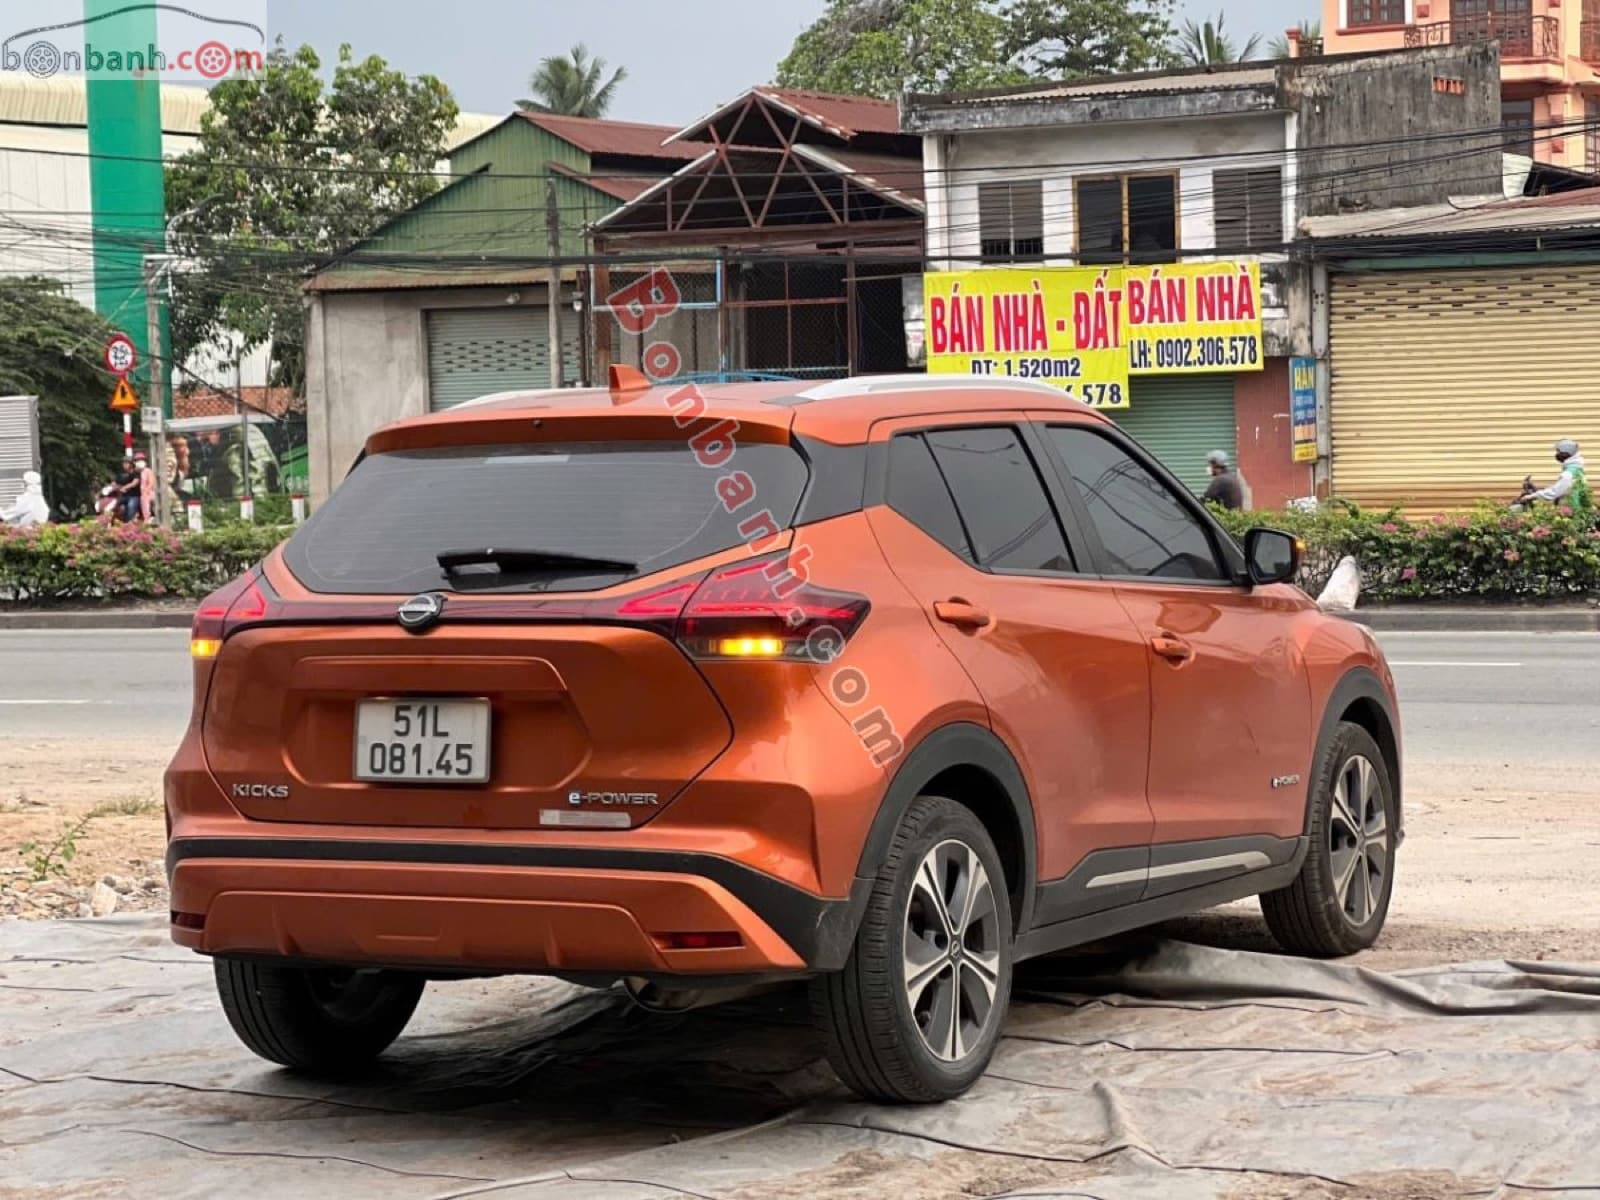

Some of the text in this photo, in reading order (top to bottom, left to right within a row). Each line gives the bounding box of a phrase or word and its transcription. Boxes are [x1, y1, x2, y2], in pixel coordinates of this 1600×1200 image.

[930, 282, 985, 354] BÁN
[992, 279, 1048, 352] NHÀ
[1072, 268, 1122, 350] ĐẤT
[1128, 265, 1256, 325] BÁN NHÀ
[1130, 335, 1258, 369] LH: 0902.306.578
[393, 704, 450, 738] 51L
[369, 742, 474, 776] 081.45
[232, 783, 289, 798] KICKS
[567, 791, 659, 805] e-POWER
